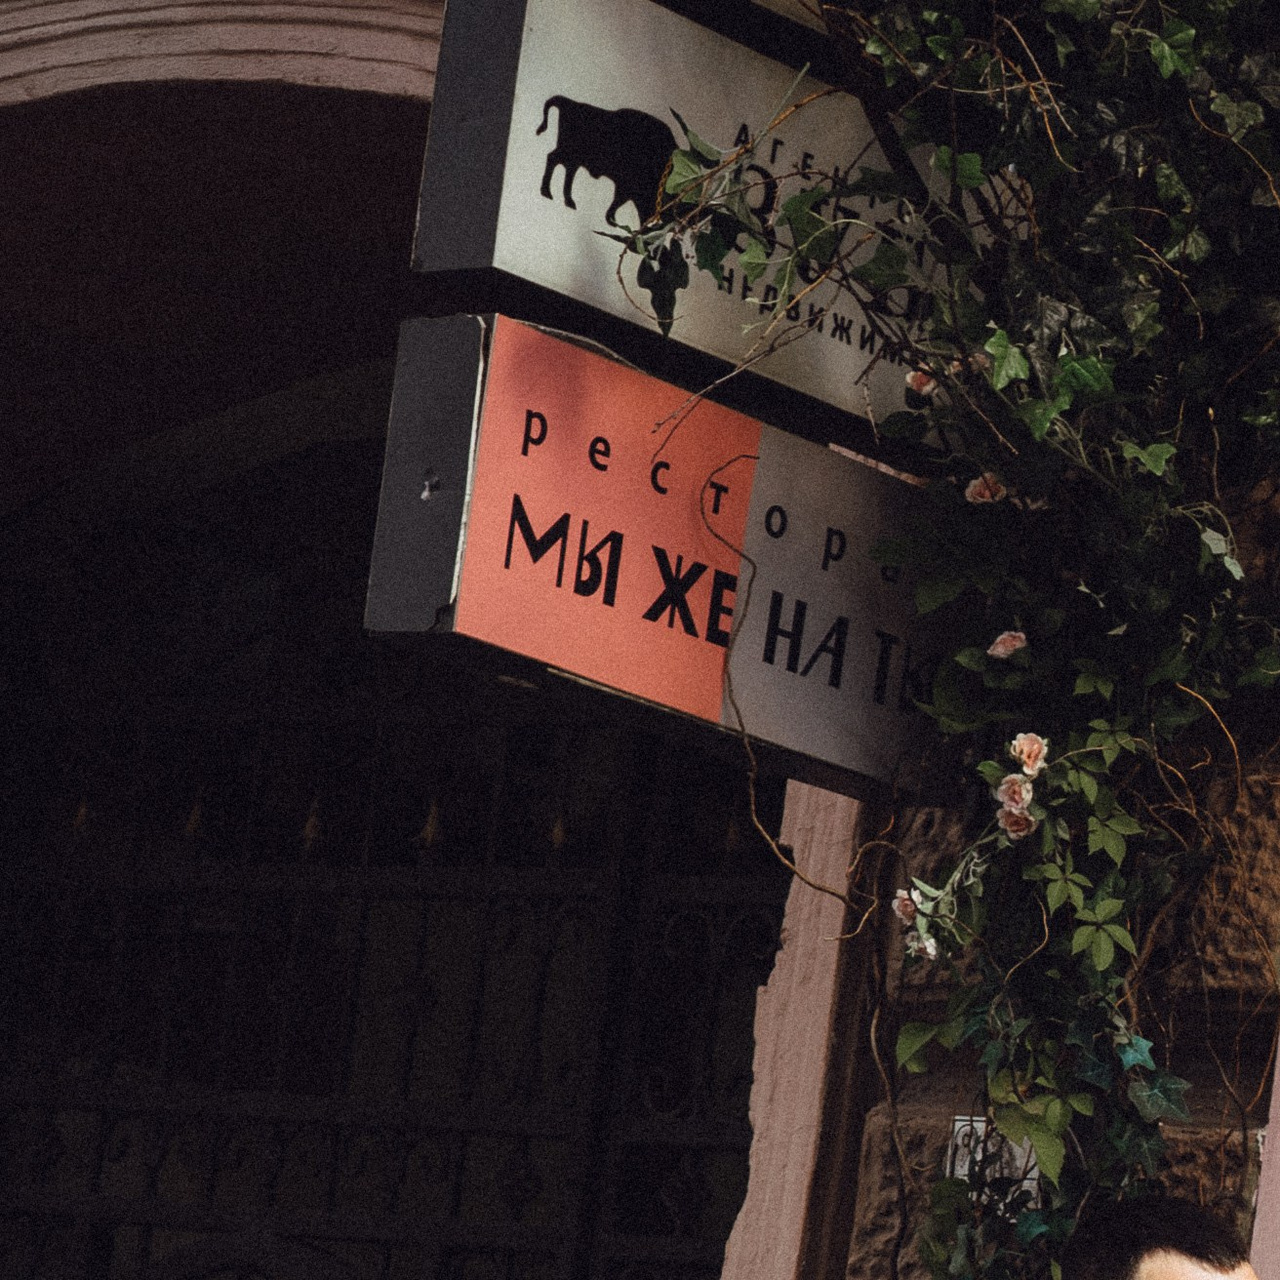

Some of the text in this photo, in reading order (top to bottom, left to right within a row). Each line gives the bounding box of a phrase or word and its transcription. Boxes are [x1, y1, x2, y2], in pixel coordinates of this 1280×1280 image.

[522, 409, 902, 583] рестора
[504, 493, 623, 606] МЫ
[642, 545, 737, 649] ЖЕ
[763, 591, 850, 689] НА
